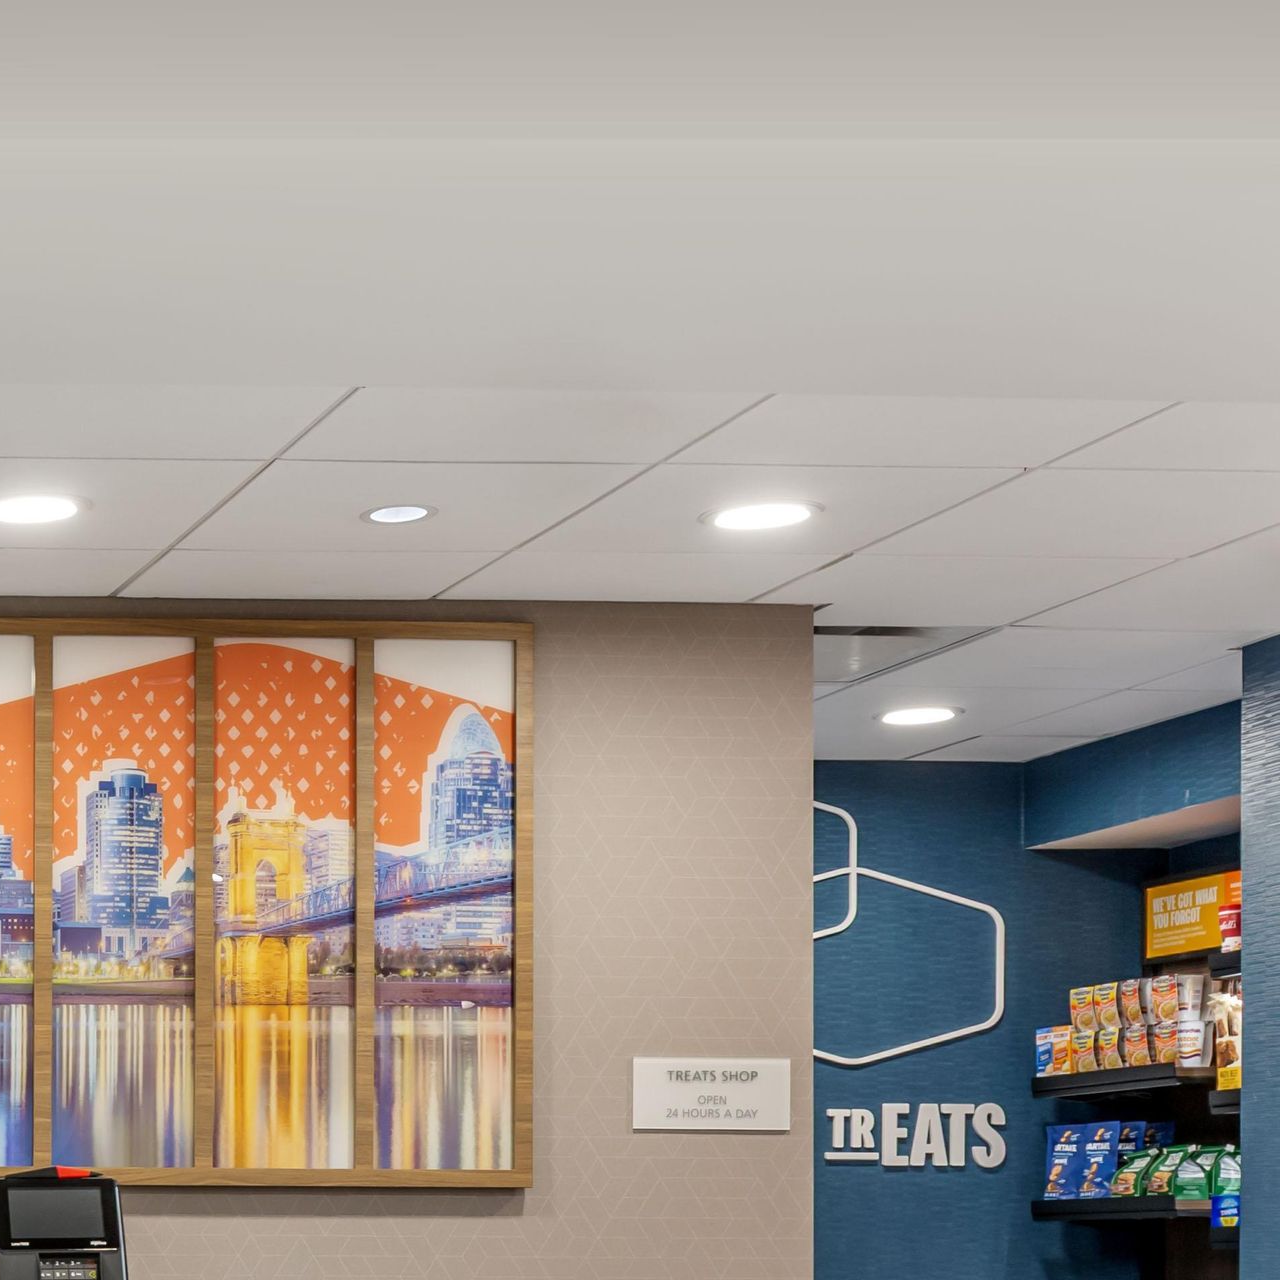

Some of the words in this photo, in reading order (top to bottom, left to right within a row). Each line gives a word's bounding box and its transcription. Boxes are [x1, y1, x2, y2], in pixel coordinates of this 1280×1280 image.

[1153, 912, 1169, 929] YOU
[1170, 907, 1200, 927] FORGOT
[667, 1070, 718, 1082] TREATS
[722, 1070, 759, 1082] SHOP
[697, 1095, 727, 1105] OPEN
[666, 1108, 680, 1119] 24
[682, 1108, 721, 1119] HOURS
[723, 1108, 733, 1119] A
[735, 1108, 759, 1119] DAY
[824, 1102, 1007, 1168] TREATS
